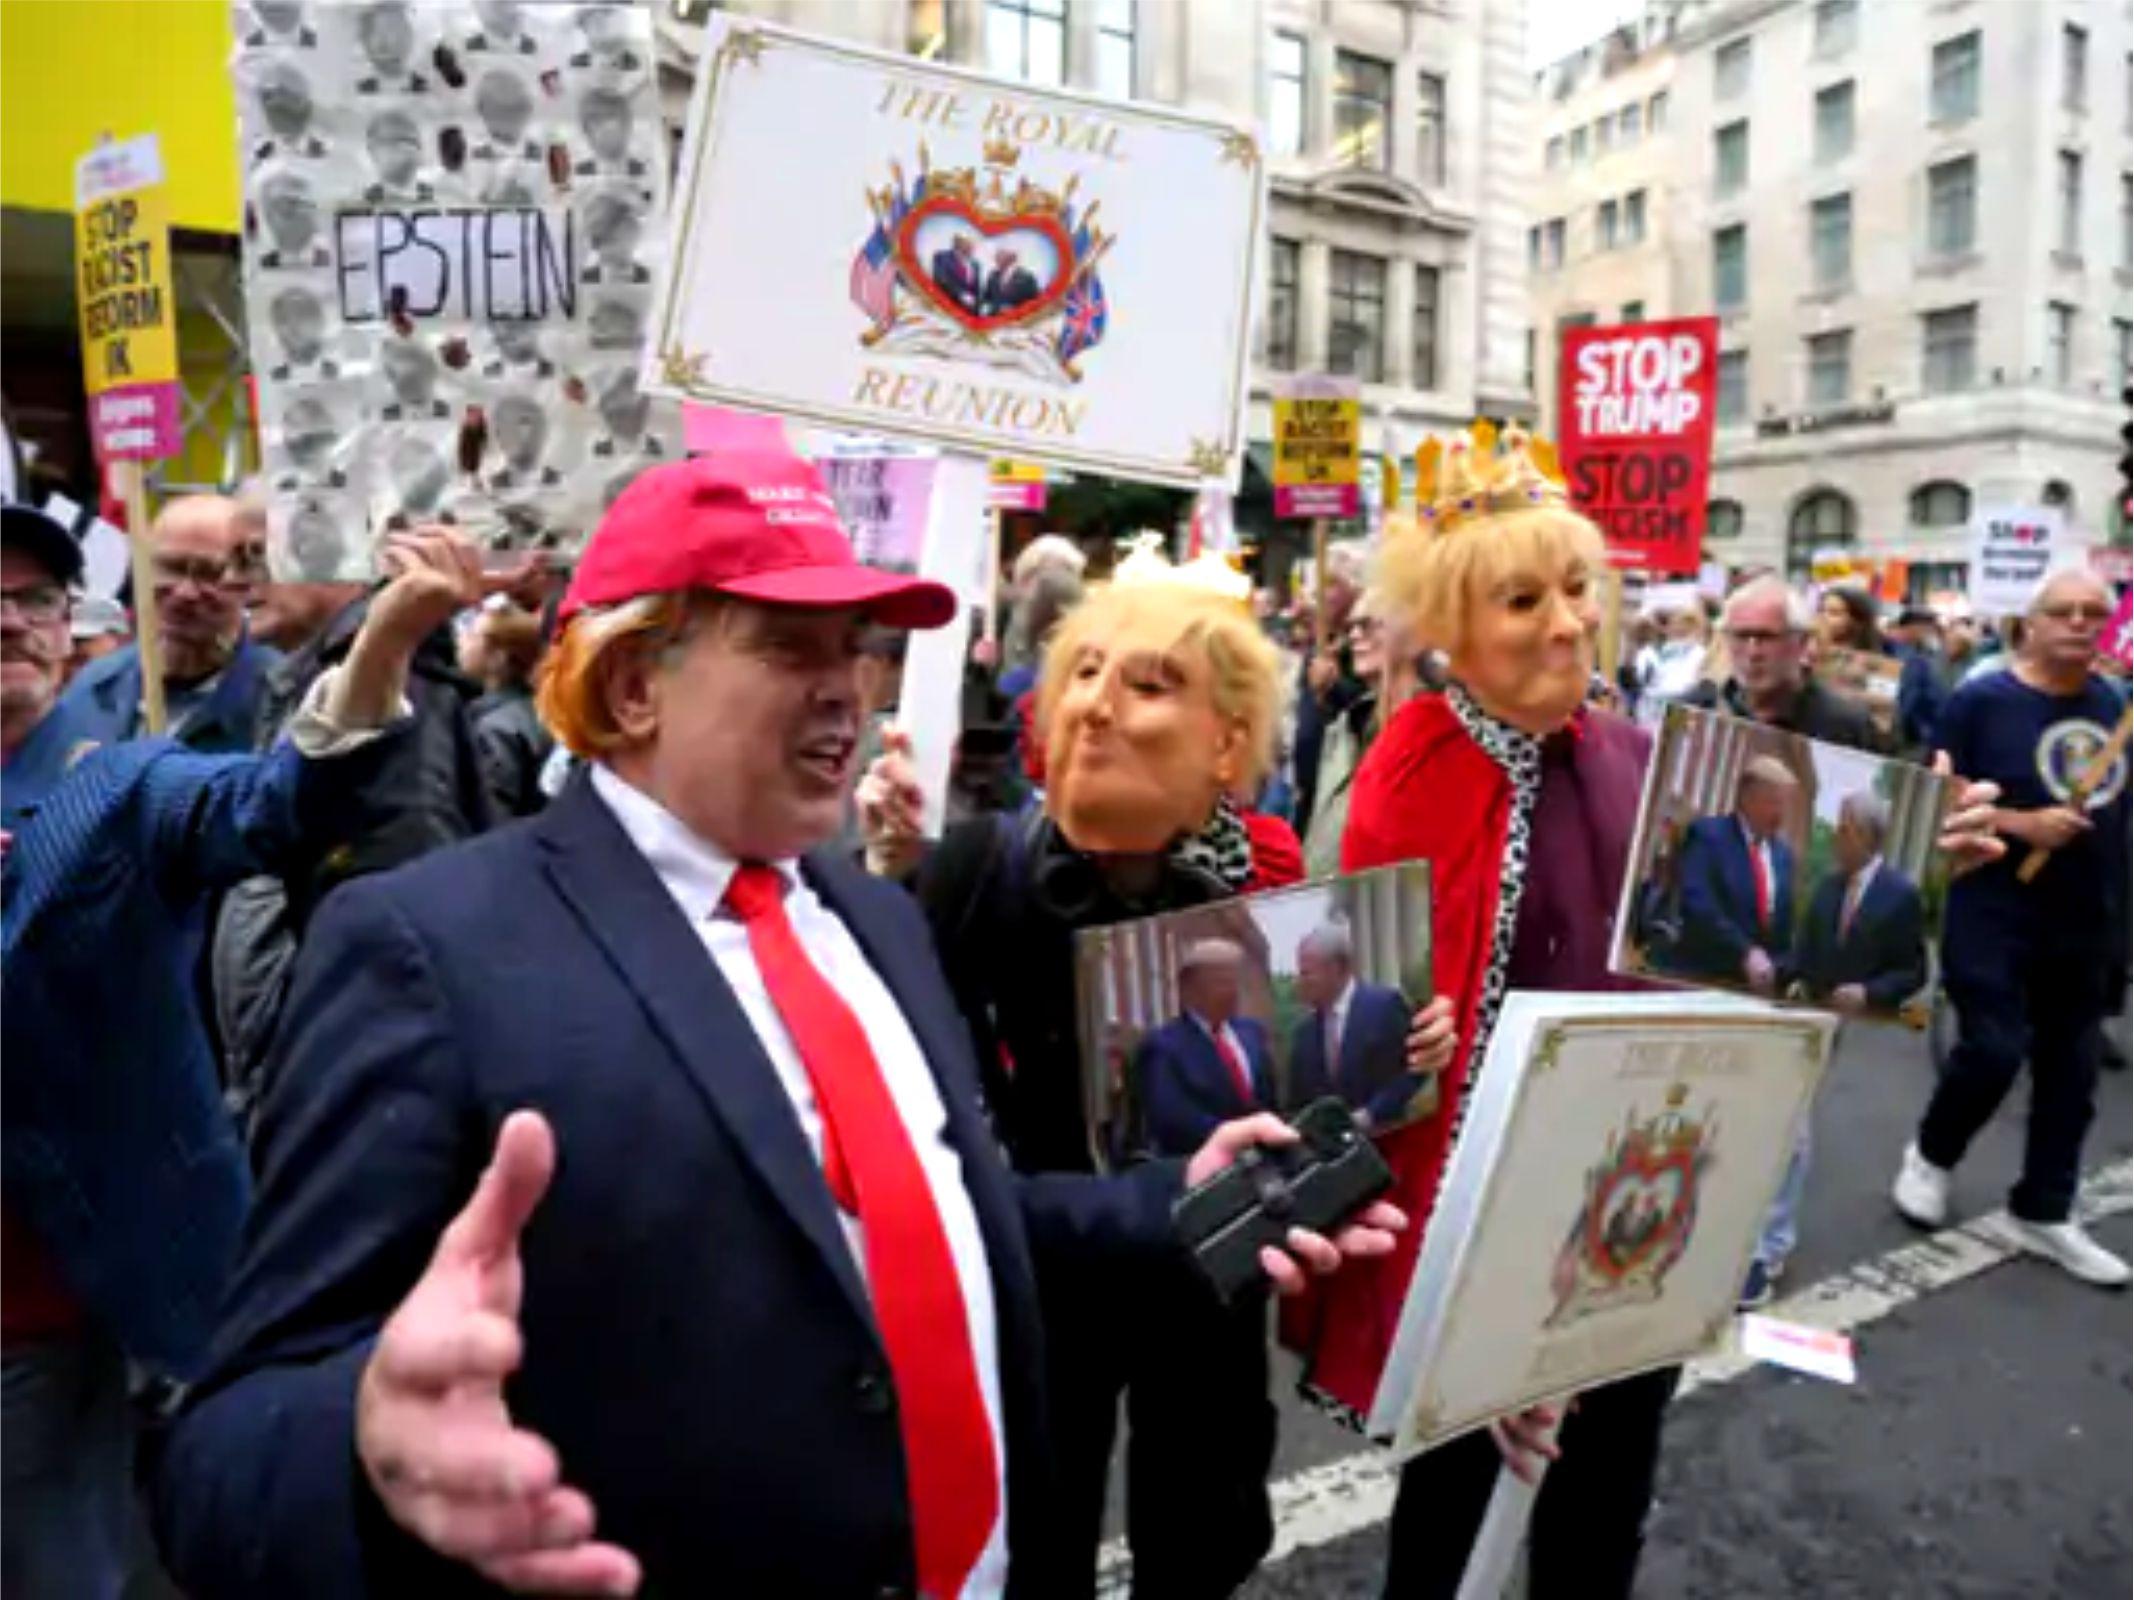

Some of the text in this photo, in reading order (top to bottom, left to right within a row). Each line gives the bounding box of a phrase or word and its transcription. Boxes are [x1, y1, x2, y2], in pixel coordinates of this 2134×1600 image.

[878, 79, 1128, 162] THE ROYAL
[84, 197, 138, 250] STOP
[335, 208, 576, 322] EPSTEIN
[1575, 335, 1702, 394] STOP
[853, 366, 1089, 435] REUNION
[1575, 391, 1701, 436] TRUMP
[1573, 452, 1691, 504] STOP
